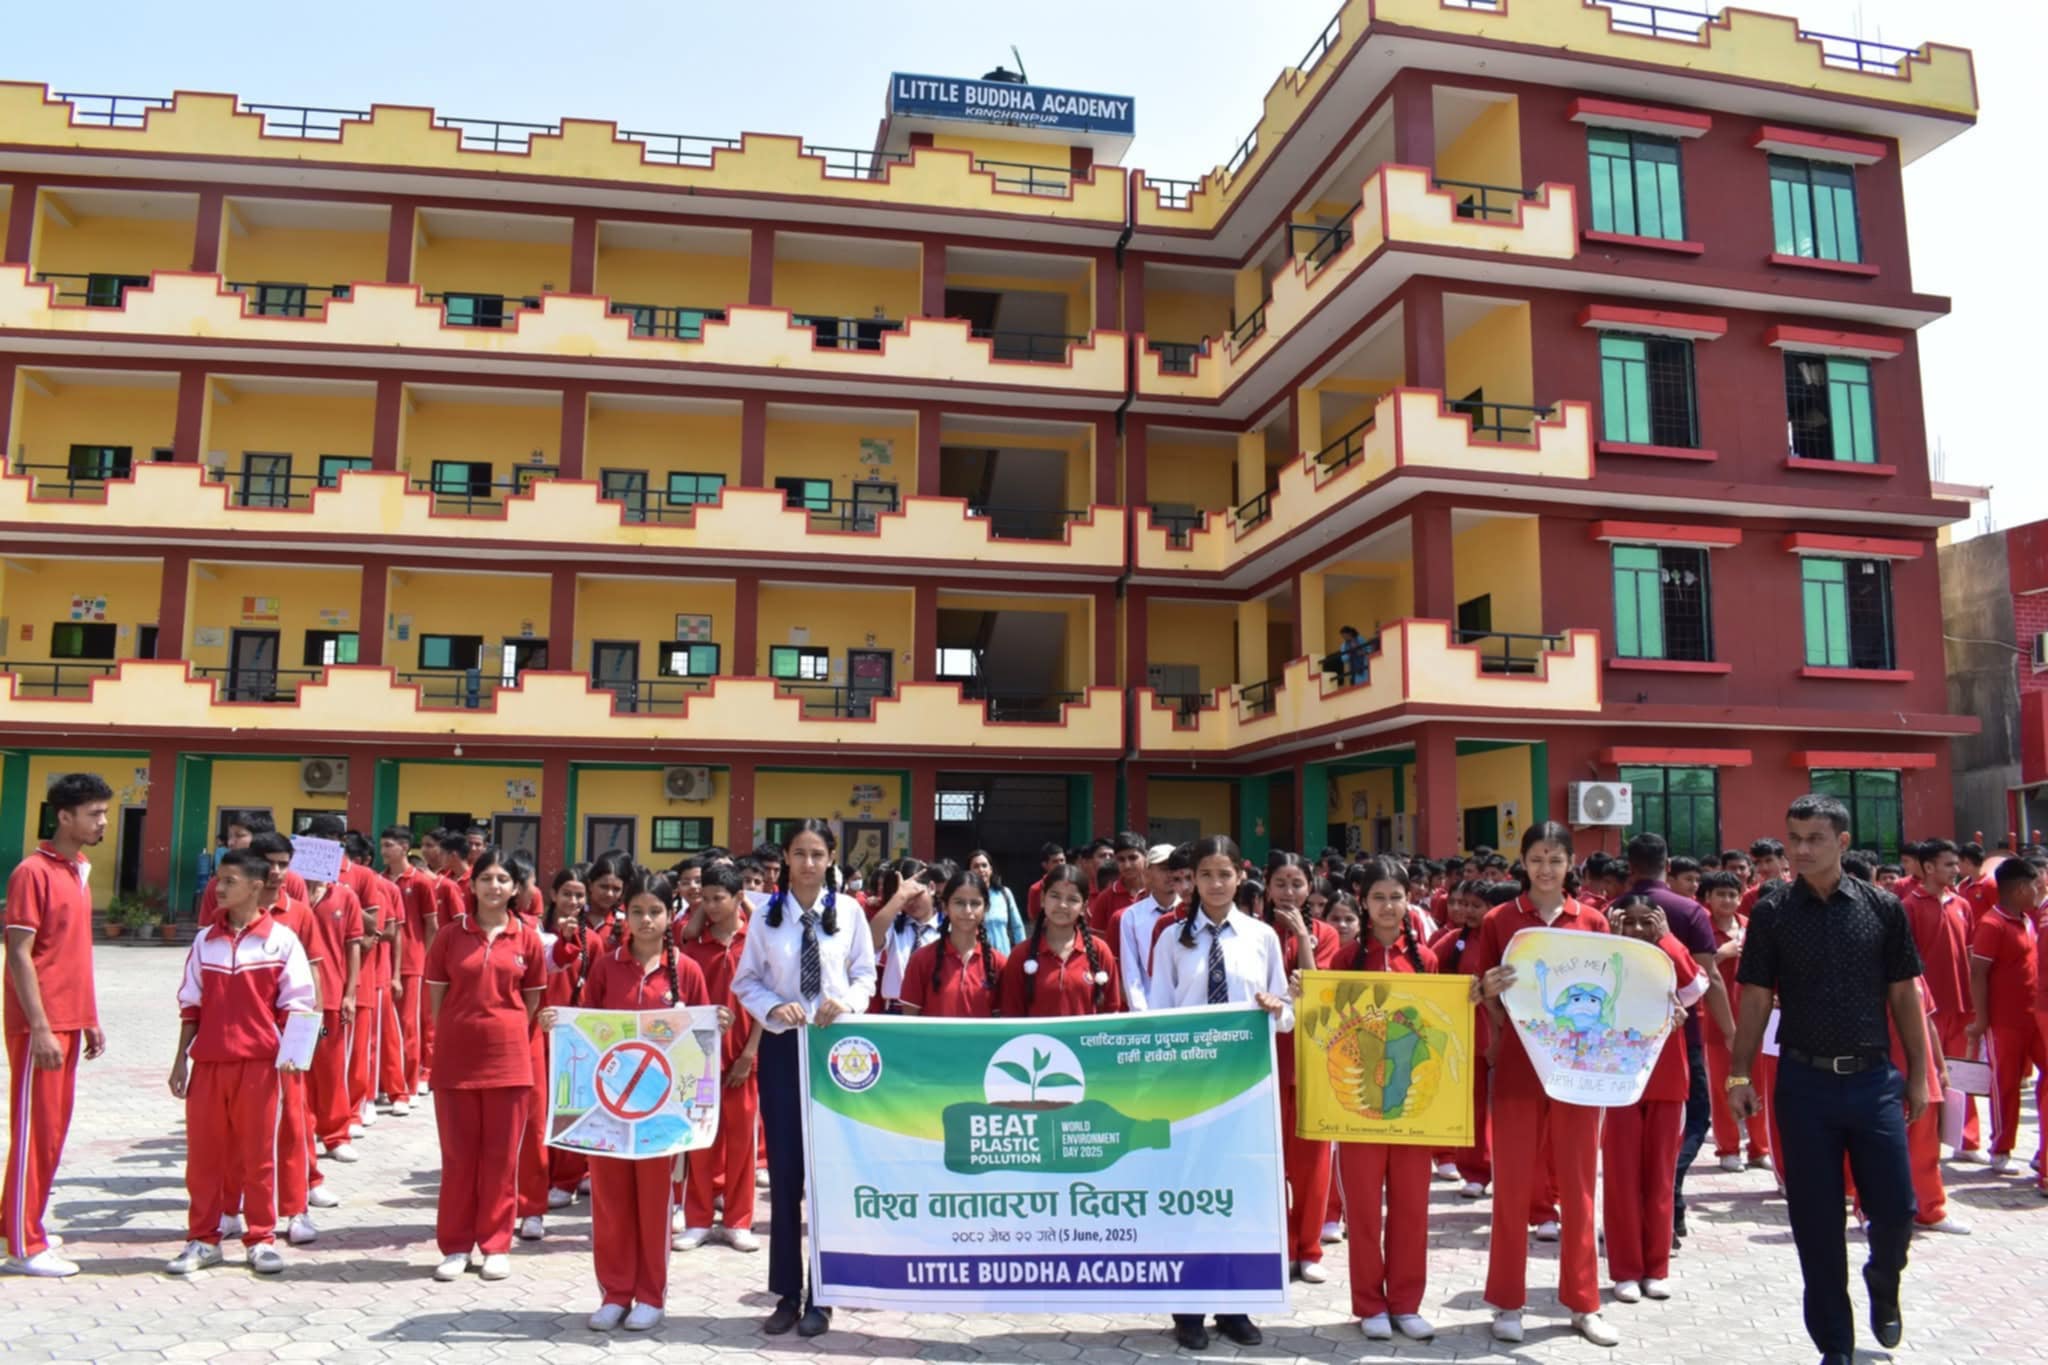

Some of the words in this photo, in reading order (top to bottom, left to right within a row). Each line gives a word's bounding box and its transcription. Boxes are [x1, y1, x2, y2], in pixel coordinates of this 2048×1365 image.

[899, 79, 959, 102] LITTLE
[965, 85, 1036, 111] BUDDHA
[1042, 93, 1129, 121] ACADEMY
[965, 106, 1059, 124] KANCHANPUR
[970, 1114, 1038, 1137] BEAT
[1061, 1121, 1091, 1132] WORLD
[970, 1137, 1040, 1153] PLASTIC
[1061, 1132, 1120, 1145] ENVIRONMENT
[970, 1153, 1041, 1165] POLLUTION
[1062, 1146, 1079, 1158] DAY
[1080, 1146, 1103, 1158] 2025
[854, 1184, 919, 1221] विश्व
[928, 1190, 1059, 1219] वातावरण
[1069, 1181, 1148, 1218] दिवस
[1158, 1188, 1234, 1217] २०२५
[1058, 1228, 1070, 1243] (5
[1073, 1228, 1103, 1243] June,
[1105, 1228, 1138, 1243] 2025)
[907, 1261, 970, 1284] LITTLE
[978, 1261, 1071, 1284] BUDDHA
[1076, 1260, 1185, 1283] ACADEMY
